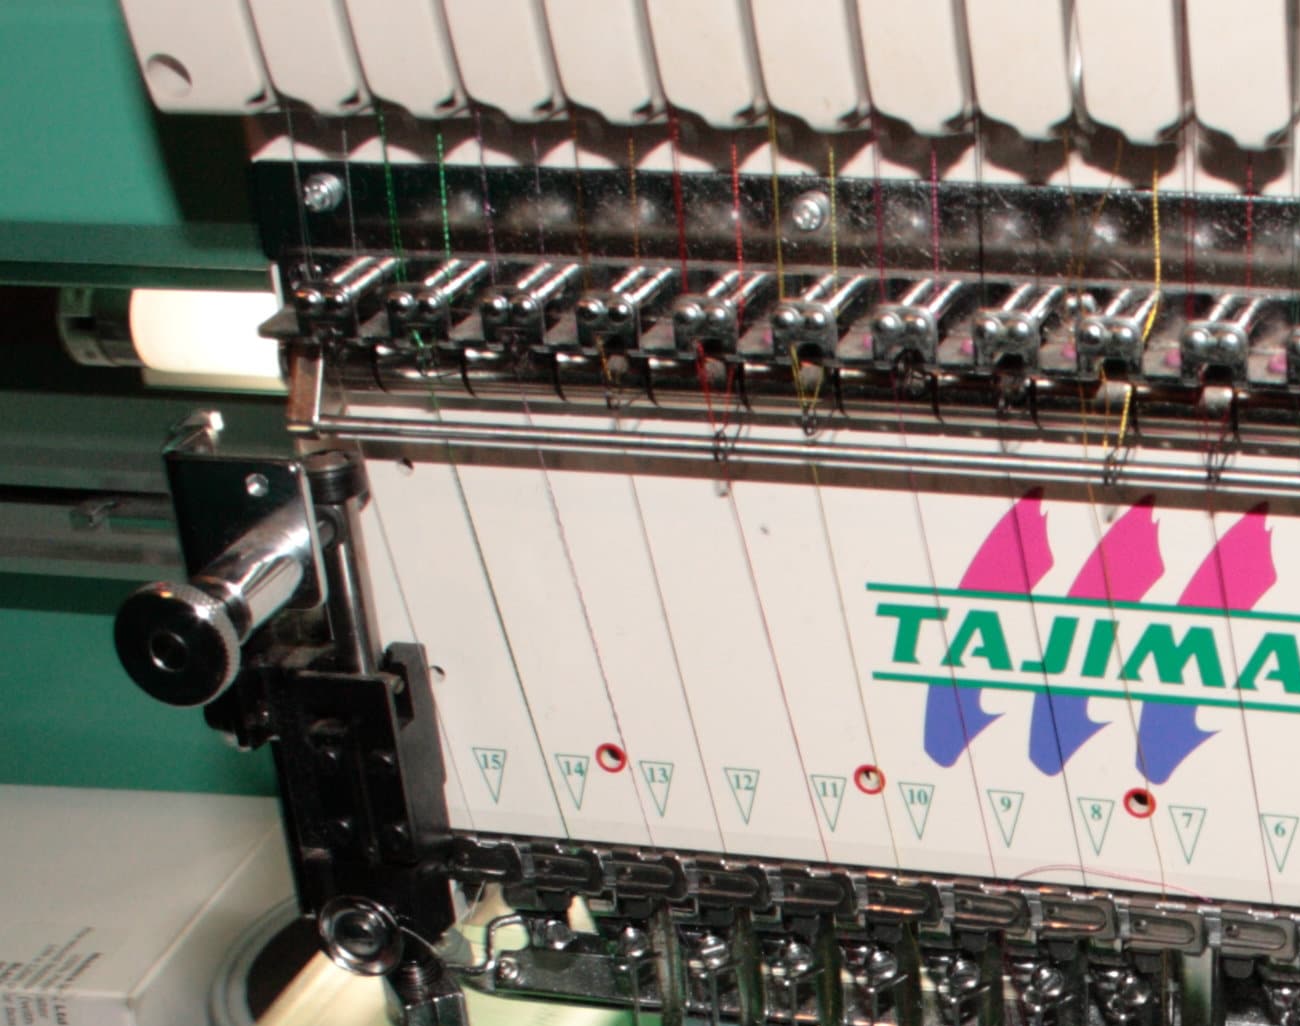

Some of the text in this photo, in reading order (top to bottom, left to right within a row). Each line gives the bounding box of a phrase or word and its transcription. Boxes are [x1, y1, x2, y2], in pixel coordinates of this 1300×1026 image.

[480, 753, 502, 770] 15
[563, 760, 586, 777] 14
[648, 767, 670, 784] 13
[731, 773, 754, 791] 12
[819, 781, 839, 799] 11
[907, 788, 929, 806] 10
[1000, 795, 1012, 812] 9
[1090, 803, 1103, 821] 8
[1180, 811, 1194, 828] 7
[1274, 821, 1286, 838] 6
